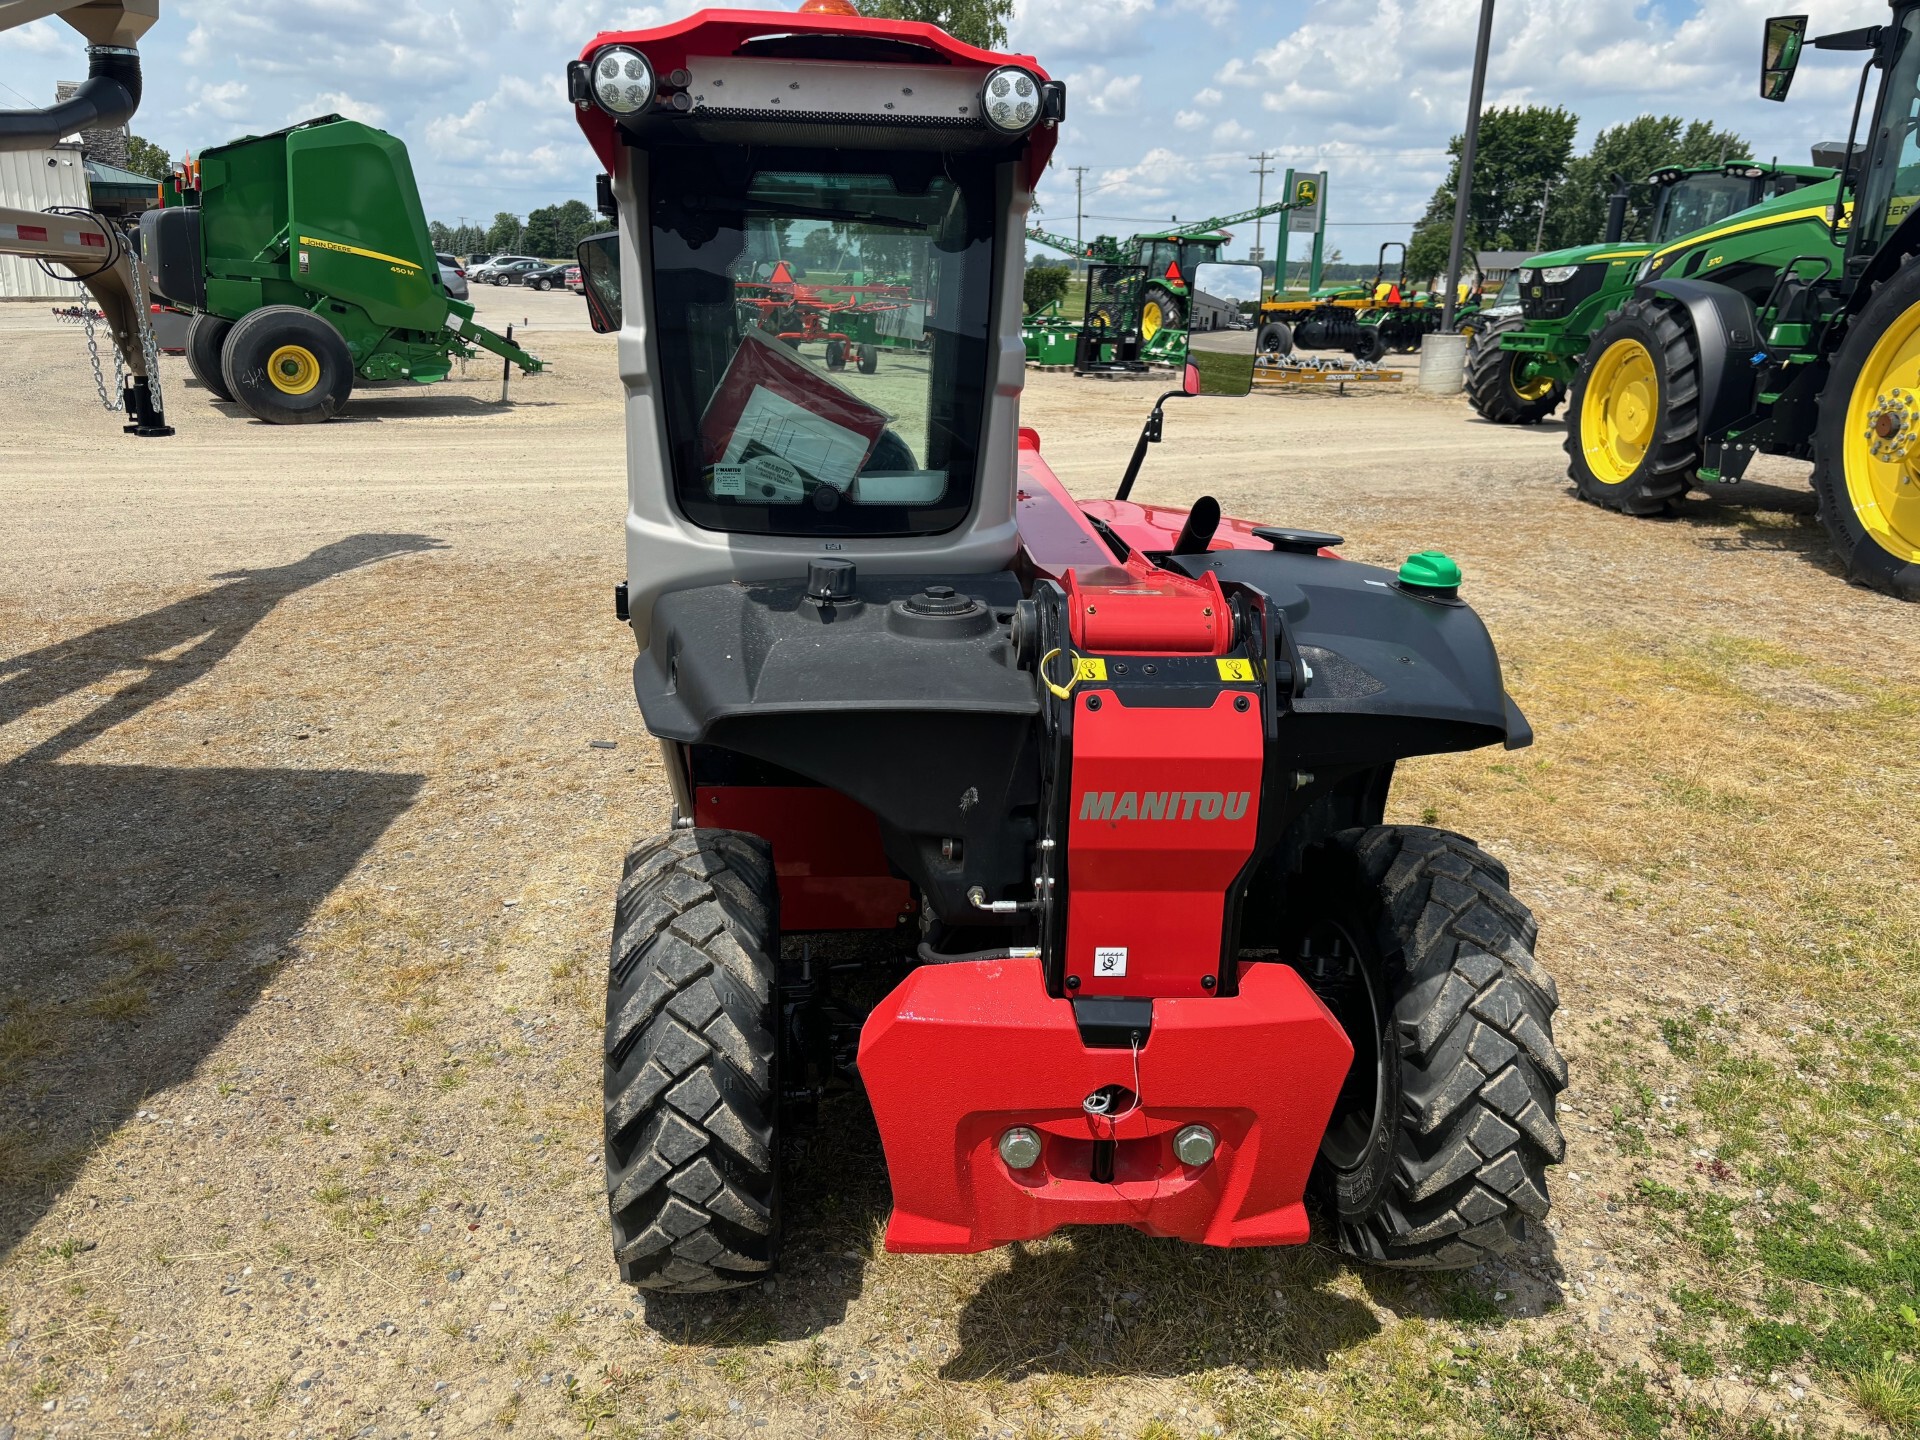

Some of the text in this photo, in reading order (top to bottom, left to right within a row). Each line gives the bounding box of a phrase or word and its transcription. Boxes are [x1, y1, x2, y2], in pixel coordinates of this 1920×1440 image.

[1887, 204, 1914, 216] EER
[305, 239, 351, 253] JOHN DEERE
[390, 266, 406, 275] 450
[763, 462, 794, 477] MANITOU
[1078, 791, 1250, 820] MANITOU
